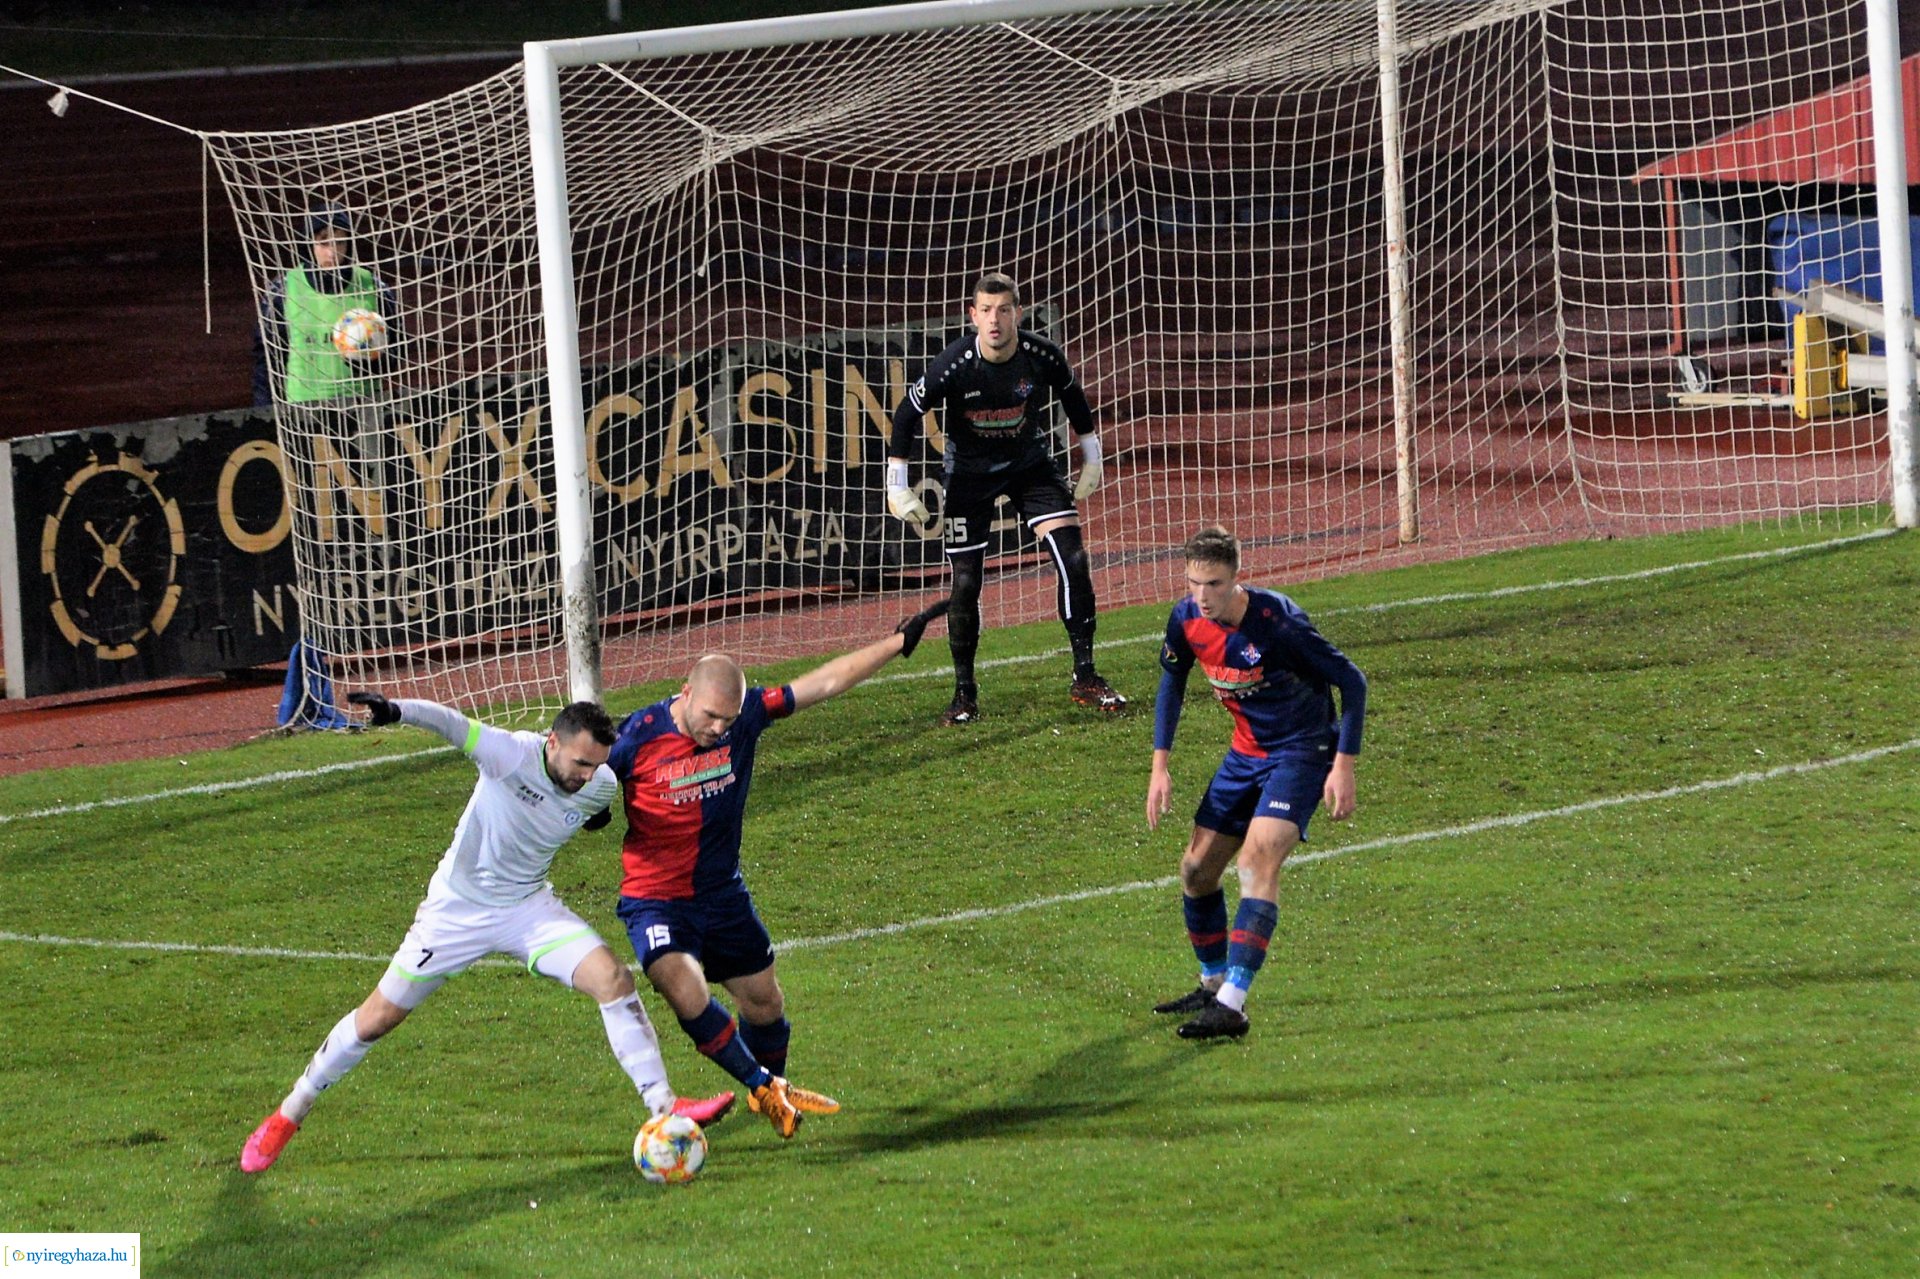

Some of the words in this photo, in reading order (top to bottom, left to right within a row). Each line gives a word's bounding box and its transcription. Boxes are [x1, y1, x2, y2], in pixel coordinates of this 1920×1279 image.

[217, 405, 553, 553] ONYX
[586, 358, 946, 505] CASIN
[944, 517, 968, 543] 95
[1269, 800, 1290, 811] JAKO
[645, 924, 671, 951] 15
[417, 948, 433, 968] 7
